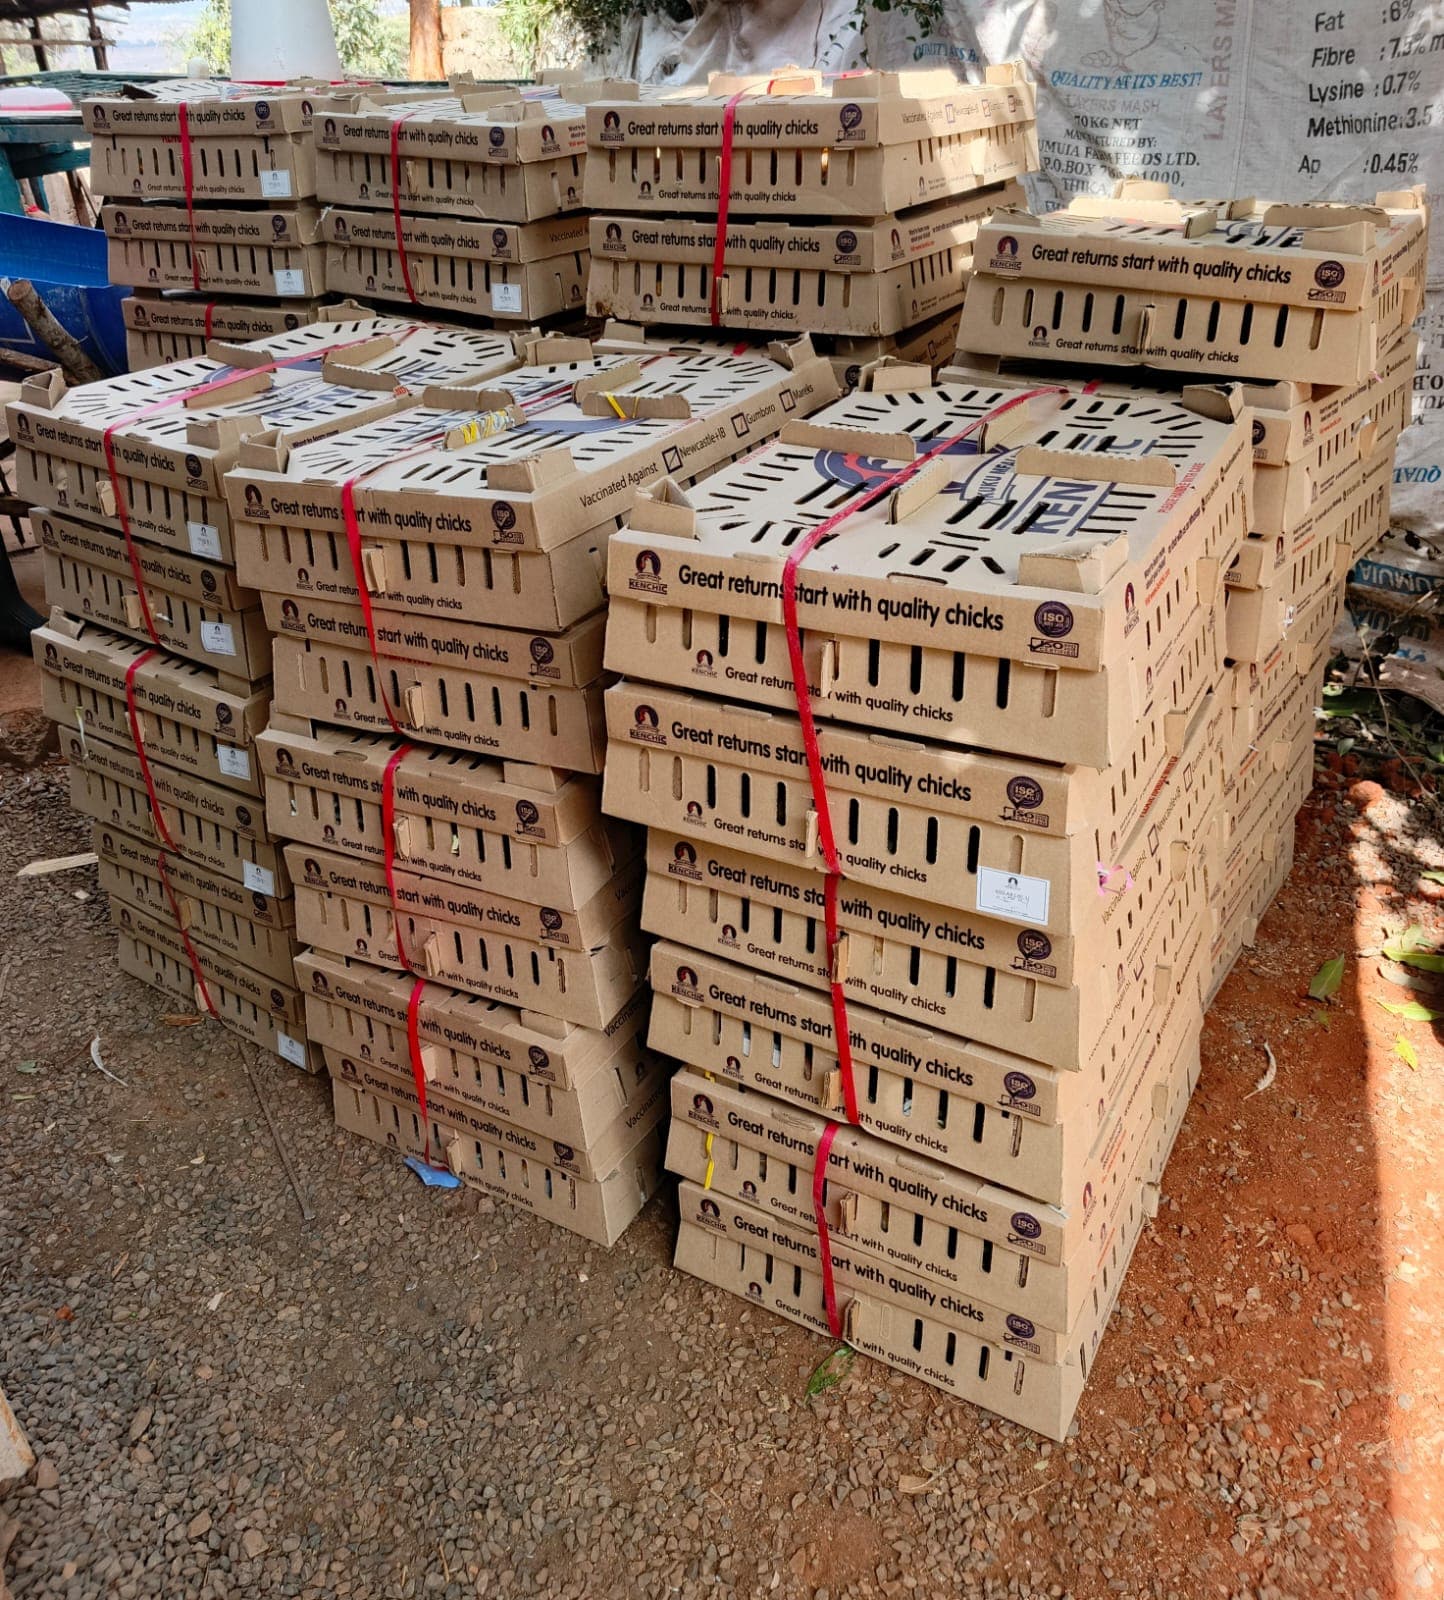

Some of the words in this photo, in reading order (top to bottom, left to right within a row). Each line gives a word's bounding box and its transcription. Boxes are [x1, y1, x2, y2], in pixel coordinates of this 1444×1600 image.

[1315, 10, 1344, 32] Fat
[1051, 71, 1112, 89] QUALITY
[1312, 48, 1355, 67] Fibre
[1309, 82, 1364, 107] Lysine
[343, 125, 363, 137] Great
[364, 127, 390, 140] returns
[409, 128, 426, 141] with
[427, 130, 453, 145] quality
[455, 131, 479, 146] chicks
[628, 121, 655, 136] Great
[658, 122, 693, 136] returns
[695, 122, 719, 136] start
[746, 122, 783, 138] quality
[785, 120, 818, 135] chicks
[1307, 114, 1398, 137] Methionine
[1166, 152, 1200, 166] LTD.
[132, 220, 151, 231] Great
[153, 221, 176, 232] returns
[194, 222, 211, 233] with
[212, 223, 236, 236] quality
[238, 224, 260, 236] chicks
[632, 230, 659, 244] Great
[661, 232, 695, 246] returns
[724, 234, 746, 249] with
[750, 235, 784, 254] quality
[787, 236, 820, 252] chicks
[1031, 244, 1069, 263] Great
[1071, 249, 1119, 268] returns
[1121, 253, 1155, 271] start
[1157, 255, 1189, 274] with
[1193, 260, 1243, 283] quality
[1246, 263, 1292, 284] chicks
[1056, 338, 1082, 350] Great
[1085, 341, 1118, 353] returns
[1146, 346, 1168, 356] with
[1170, 348, 1205, 362] quality
[1207, 350, 1239, 363] chicks
[36, 424, 56, 439] Great
[58, 431, 83, 447] returns
[85, 437, 102, 451] start
[123, 448, 149, 468] quality
[150, 452, 175, 472] chicks
[579, 478, 627, 509] Vaccinated
[627, 462, 659, 486] Against
[746, 403, 776, 426] Gumboro
[271, 498, 300, 515] Great
[302, 503, 339, 520] returns
[368, 508, 392, 525] with
[395, 510, 432, 533] quality
[436, 513, 472, 533] chicks
[628, 577, 668, 595] KENCHIC
[678, 564, 724, 590] Great
[832, 588, 872, 613] with
[877, 596, 940, 628] quality
[945, 602, 1004, 632] chicks
[307, 613, 336, 631] Great
[378, 628, 402, 644] start
[404, 631, 429, 649] with
[431, 637, 470, 660] quality
[473, 644, 508, 663] chicks
[725, 666, 758, 684] Great
[835, 690, 862, 705] with
[865, 697, 908, 714] quality
[912, 703, 953, 722] chicks
[630, 728, 667, 745] KENCHIC
[671, 721, 714, 746] Great
[717, 733, 771, 758] returns
[774, 743, 811, 766] star
[854, 764, 913, 794] quality
[917, 773, 971, 802] chicks
[302, 762, 330, 781] Great
[332, 772, 369, 791] returns
[397, 786, 420, 803] with
[422, 793, 459, 818] quality
[461, 800, 496, 821] chicks
[714, 817, 744, 834] Great
[747, 824, 786, 844] returns
[846, 854, 887, 875] quality
[891, 863, 927, 883] chicks
[329, 871, 357, 889] Great
[397, 888, 420, 904] start
[422, 893, 445, 910] with
[447, 900, 484, 922] quality
[487, 907, 521, 927] chicks
[668, 863, 703, 881] KENCHIC
[707, 859, 747, 884] Great
[750, 874, 800, 900] returns
[840, 899, 873, 920] with
[877, 909, 930, 939] quality
[934, 921, 985, 950] chicks
[746, 942, 776, 961] Great
[778, 953, 815, 973] returns
[844, 976, 867, 990] with
[870, 984, 908, 1005] quality
[911, 995, 947, 1015] chicks
[708, 984, 746, 1009] Great
[749, 1000, 797, 1027] returns
[800, 1017, 833, 1039] start
[870, 1042, 922, 1073] quality
[925, 1058, 974, 1087] chicks
[728, 1111, 764, 1137] Great
[767, 1129, 815, 1157] returns
[853, 1161, 884, 1183] with
[888, 1167, 938, 1205] quality
[942, 1194, 988, 1223] chicks
[734, 1215, 769, 1240] Great
[772, 1228, 817, 1258] returns
[855, 1264, 885, 1285] with
[888, 1268, 937, 1306] quality
[940, 1295, 984, 1323] chicks
